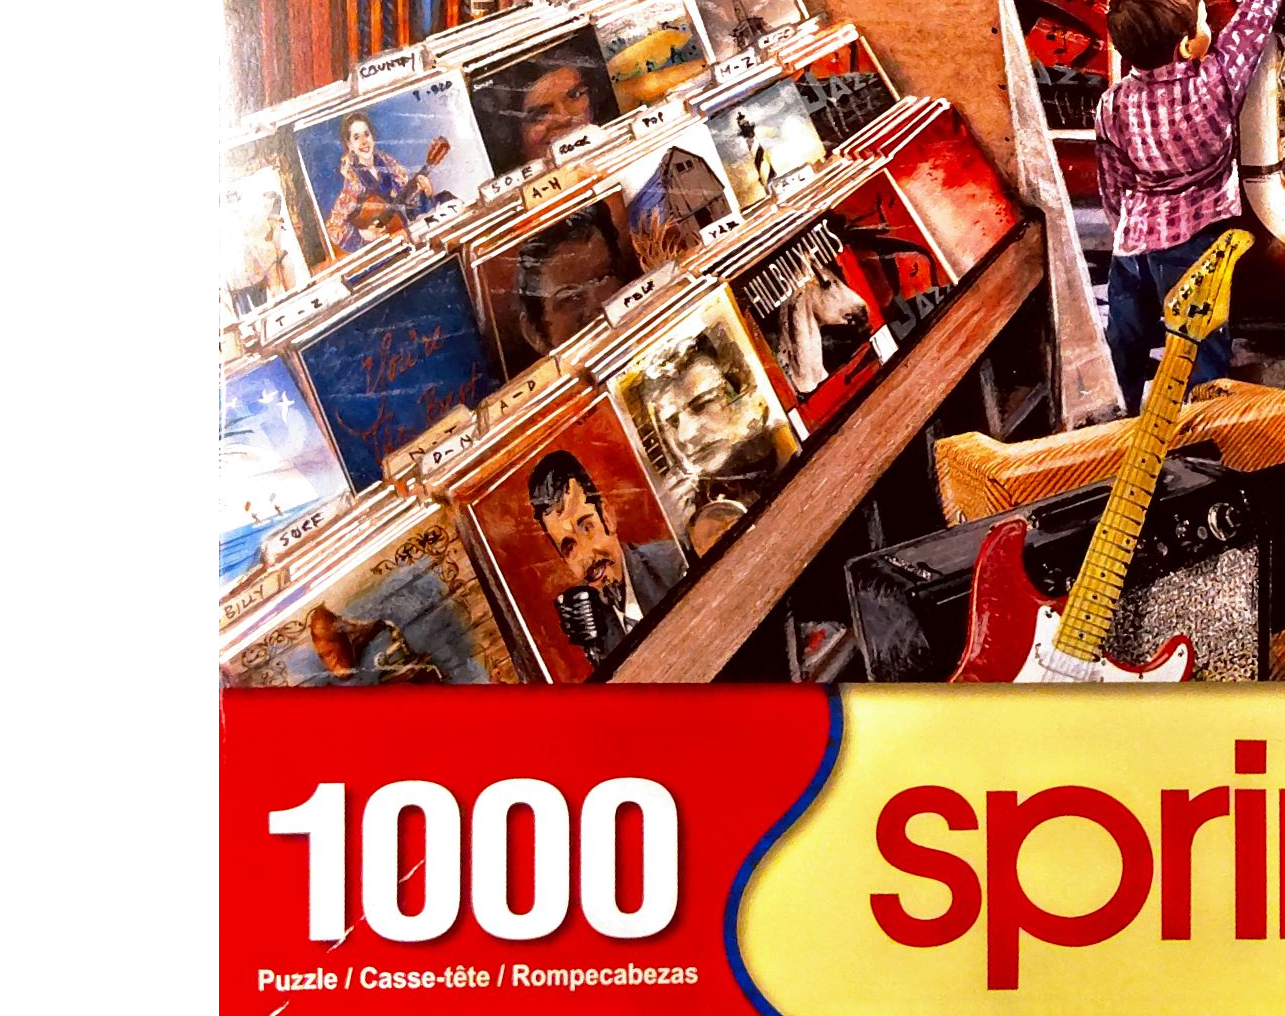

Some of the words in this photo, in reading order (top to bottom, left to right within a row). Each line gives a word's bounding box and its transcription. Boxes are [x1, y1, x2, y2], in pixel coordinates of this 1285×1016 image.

[743, 242, 816, 319] HILLBILLY
[801, 218, 844, 270] HITS
[268, 777, 680, 943] 1000
[257, 967, 339, 992] Puzzle
[359, 963, 491, 990] Casse-tête
[512, 961, 699, 989] Rompecabezas
